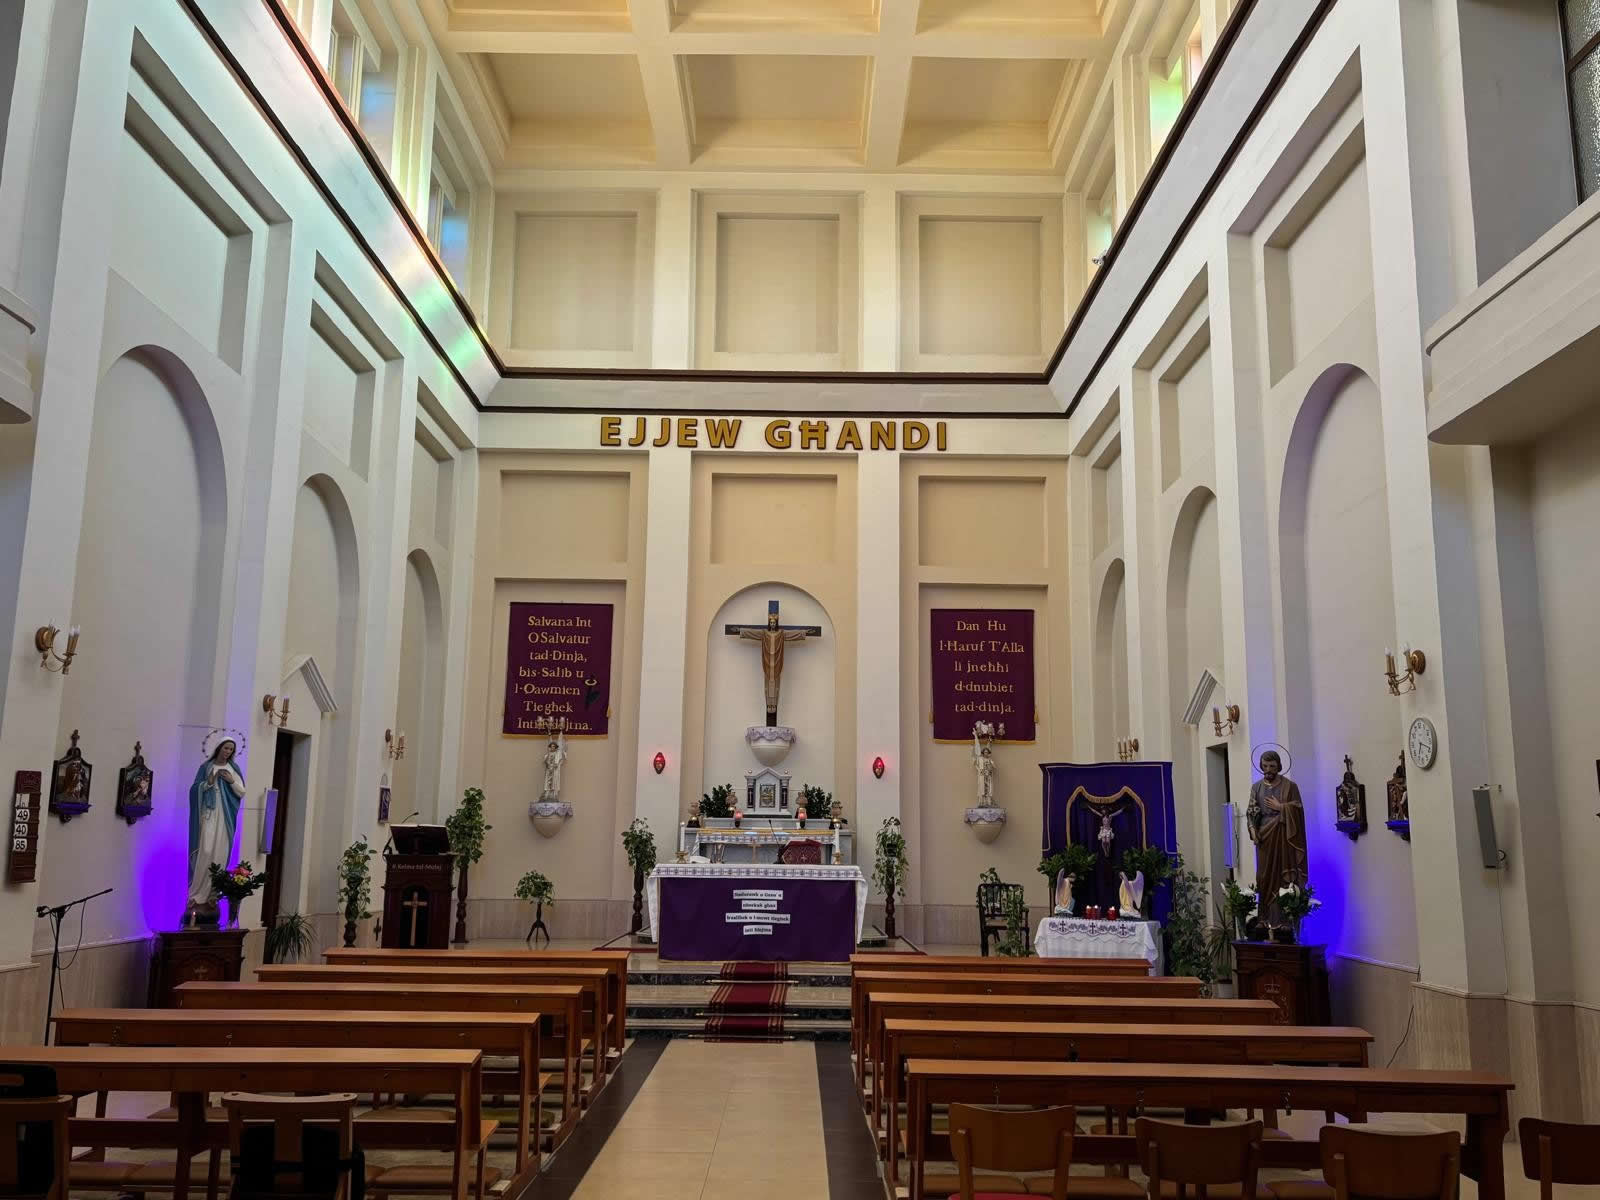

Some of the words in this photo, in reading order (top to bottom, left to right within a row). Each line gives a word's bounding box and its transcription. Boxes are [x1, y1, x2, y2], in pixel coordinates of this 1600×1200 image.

[600, 416, 742, 448] EJJEW
[528, 615, 573, 627] Salvana
[576, 616, 592, 628] Int
[957, 621, 980, 631] Dan
[988, 621, 1006, 631] Hu
[540, 632, 591, 645] Salvatur
[576, 670, 584, 678] u
[17, 810, 29, 820] 49
[16, 824, 27, 835] 40
[15, 840, 26, 850] 85
